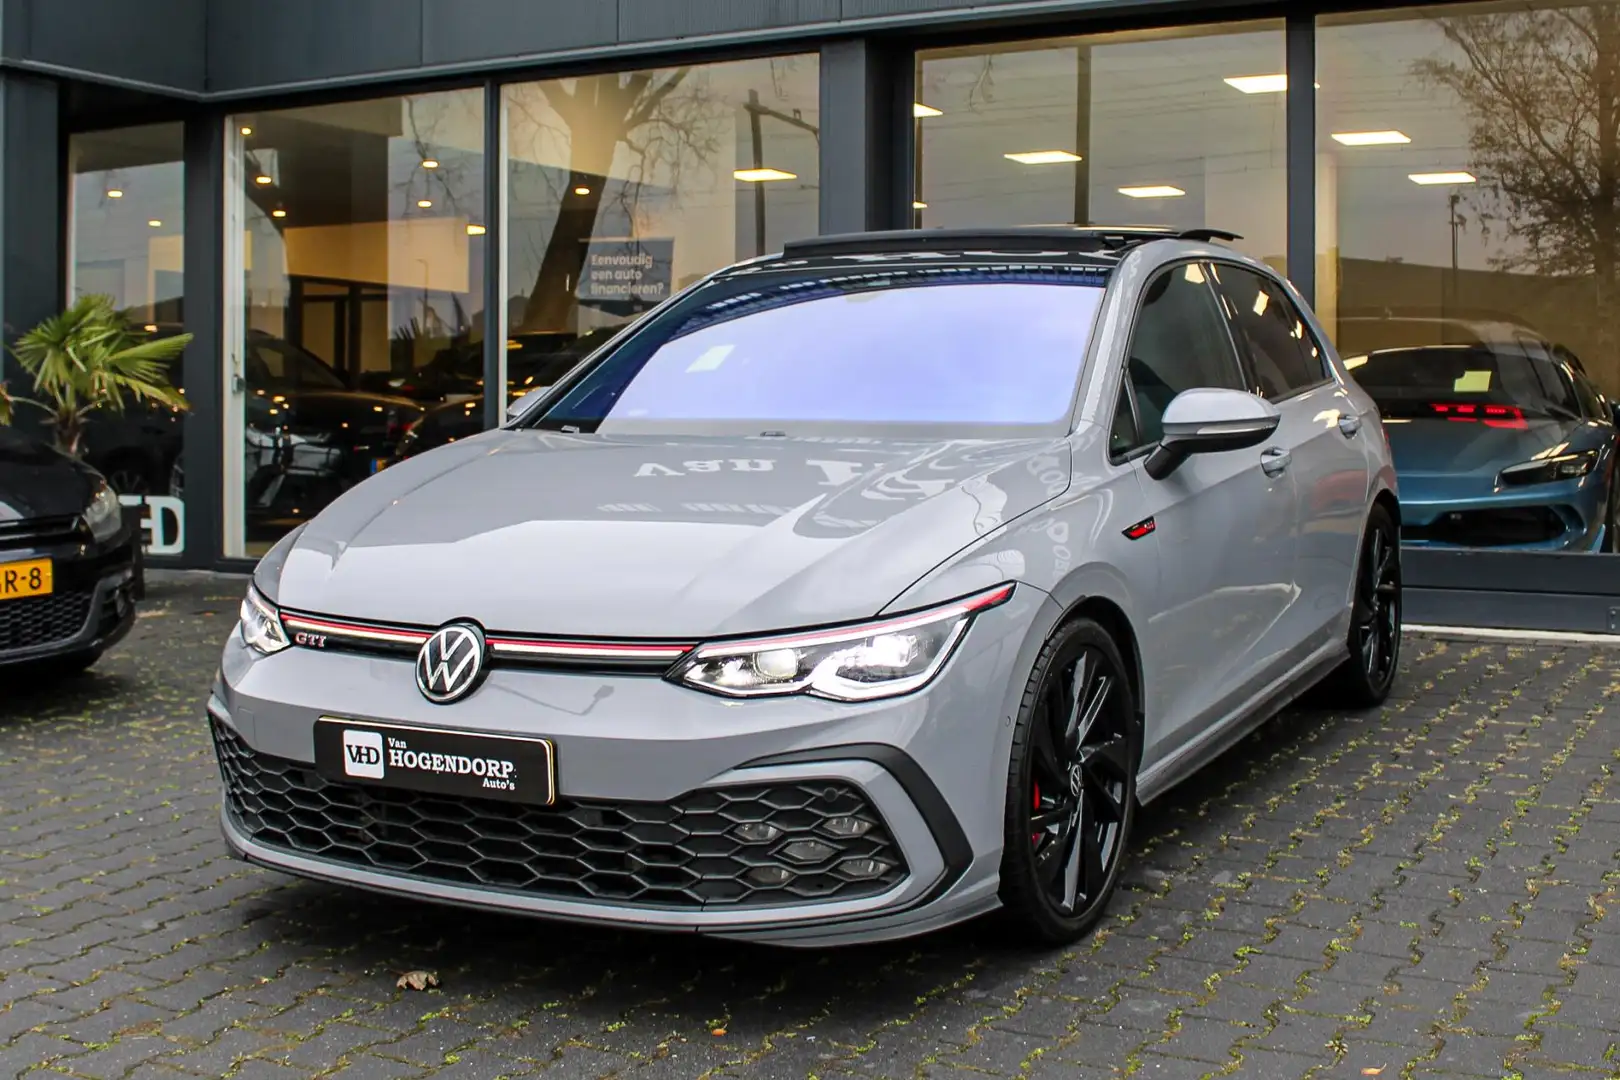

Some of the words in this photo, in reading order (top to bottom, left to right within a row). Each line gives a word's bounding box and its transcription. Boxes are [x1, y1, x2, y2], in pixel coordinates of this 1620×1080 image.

[590, 252, 654, 269] Eenvoudig
[590, 270, 613, 280] een
[614, 269, 643, 280] auto
[590, 282, 664, 295] financieren?
[0, 567, 42, 593] R-8
[295, 632, 327, 648] GTI
[387, 737, 408, 749] Van
[389, 749, 514, 779] HOGENDORP
[482, 777, 516, 791] Auto's
